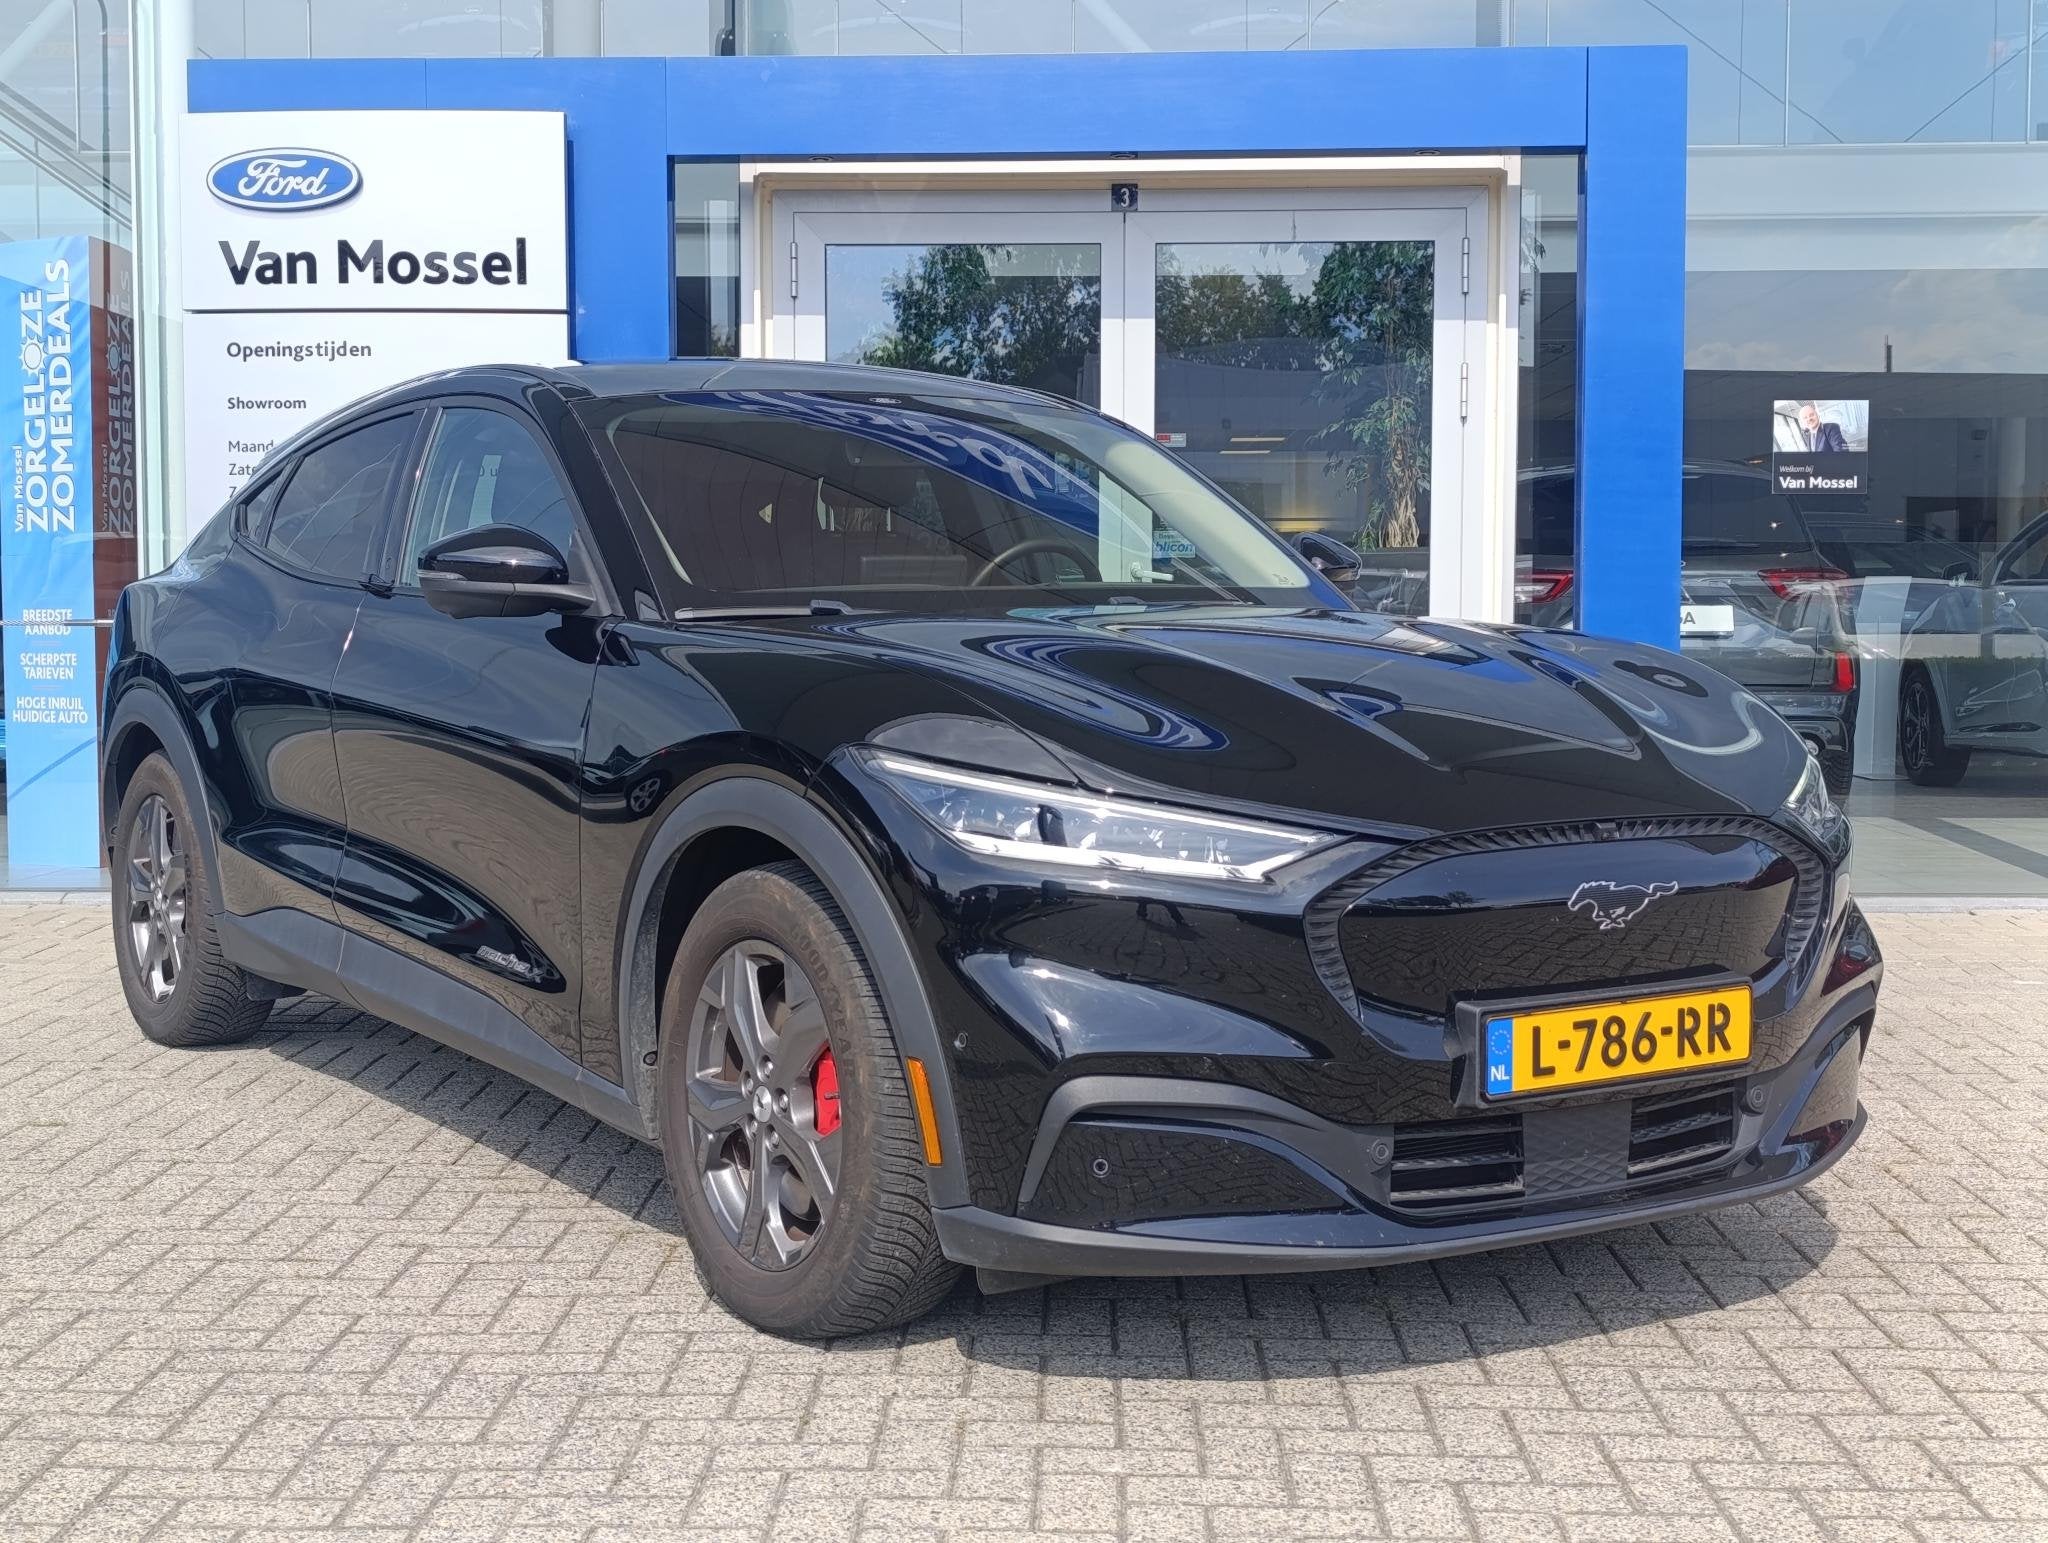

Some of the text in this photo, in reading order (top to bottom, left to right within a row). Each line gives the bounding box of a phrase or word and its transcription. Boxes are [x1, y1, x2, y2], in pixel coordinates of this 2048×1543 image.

[237, 157, 330, 197] Ford
[1121, 188, 1130, 206] 3
[218, 237, 527, 286] Van Mossel
[226, 341, 372, 362] Openingstijden
[45, 259, 75, 533] ZOMERDEALS
[227, 396, 307, 410] Showroom
[1779, 465, 1804, 473] Welkom
[12, 445, 24, 532] Van Mossel
[1779, 475, 1858, 489] Van Mossel
[23, 608, 73, 621] BREEDSTE
[1680, 611, 1696, 624] A
[25, 624, 72, 636] AANBOD
[20, 653, 77, 666] SCHERPSTE
[24, 667, 74, 680] TARIEVEN
[16, 697, 84, 710] HOGE INRUIL
[12, 710, 88, 724] HUIDIGE AUTO
[1531, 1002, 1732, 1078] L-786-RR
[1490, 1064, 1510, 1081] NL
